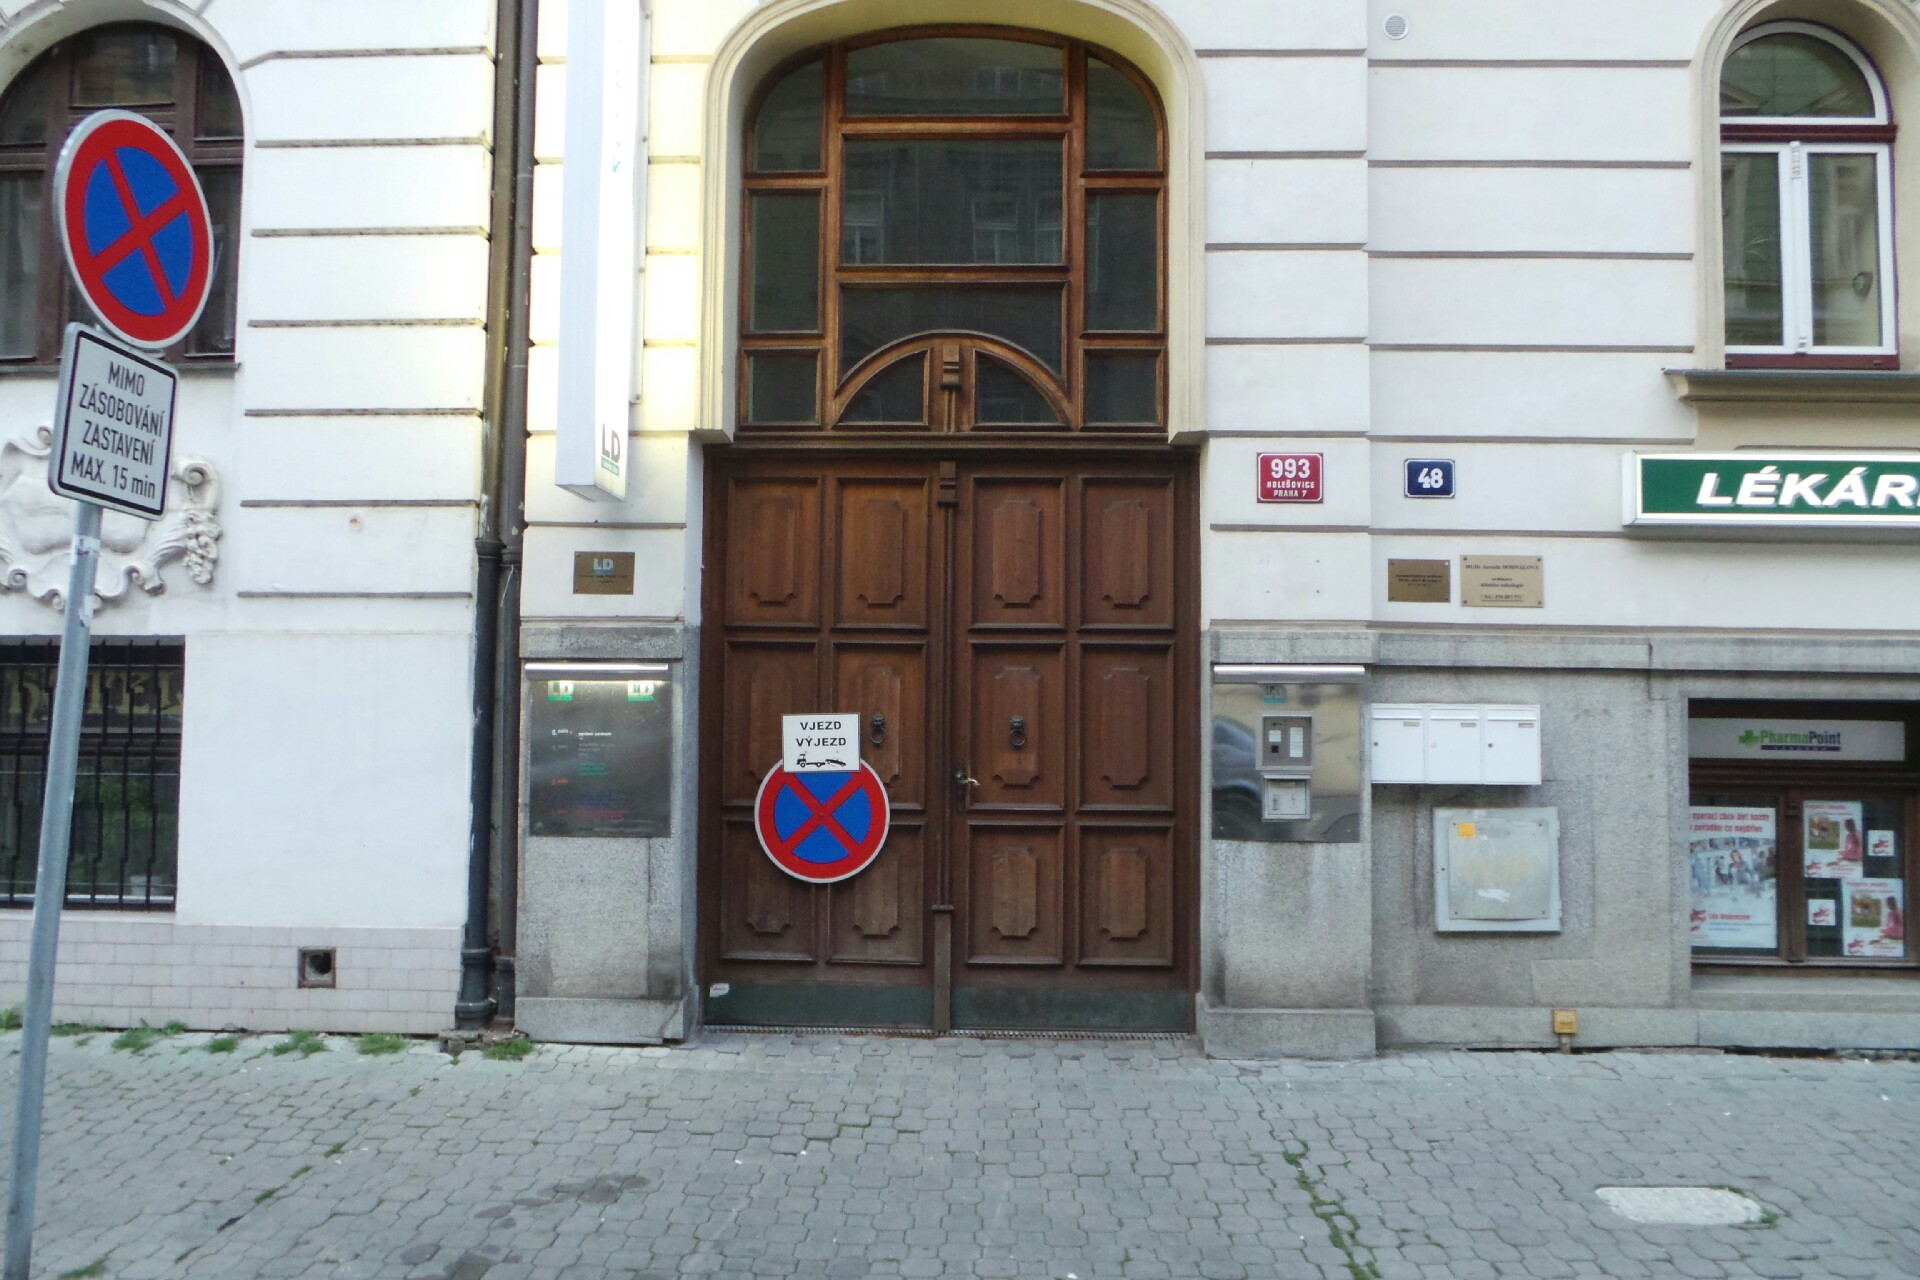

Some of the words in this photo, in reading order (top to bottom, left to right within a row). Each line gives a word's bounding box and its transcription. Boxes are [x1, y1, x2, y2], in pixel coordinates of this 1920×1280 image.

[108, 361, 144, 397] MIMO
[79, 383, 165, 437] ZÁSOBOVÁNÍ
[83, 420, 154, 466] ZASTAVENÍ
[602, 423, 620, 463] LD
[71, 451, 106, 485] MAX.
[113, 464, 128, 490] 15
[131, 475, 155, 499] min
[1267, 479, 1315, 489] HOLEŠOVICE
[1271, 459, 1310, 478] 993
[1418, 468, 1443, 488] 48
[1697, 466, 1920, 508] LÉKÁR
[796, 736, 846, 747] VÝJEZD
[800, 721, 841, 730] VJEZD
